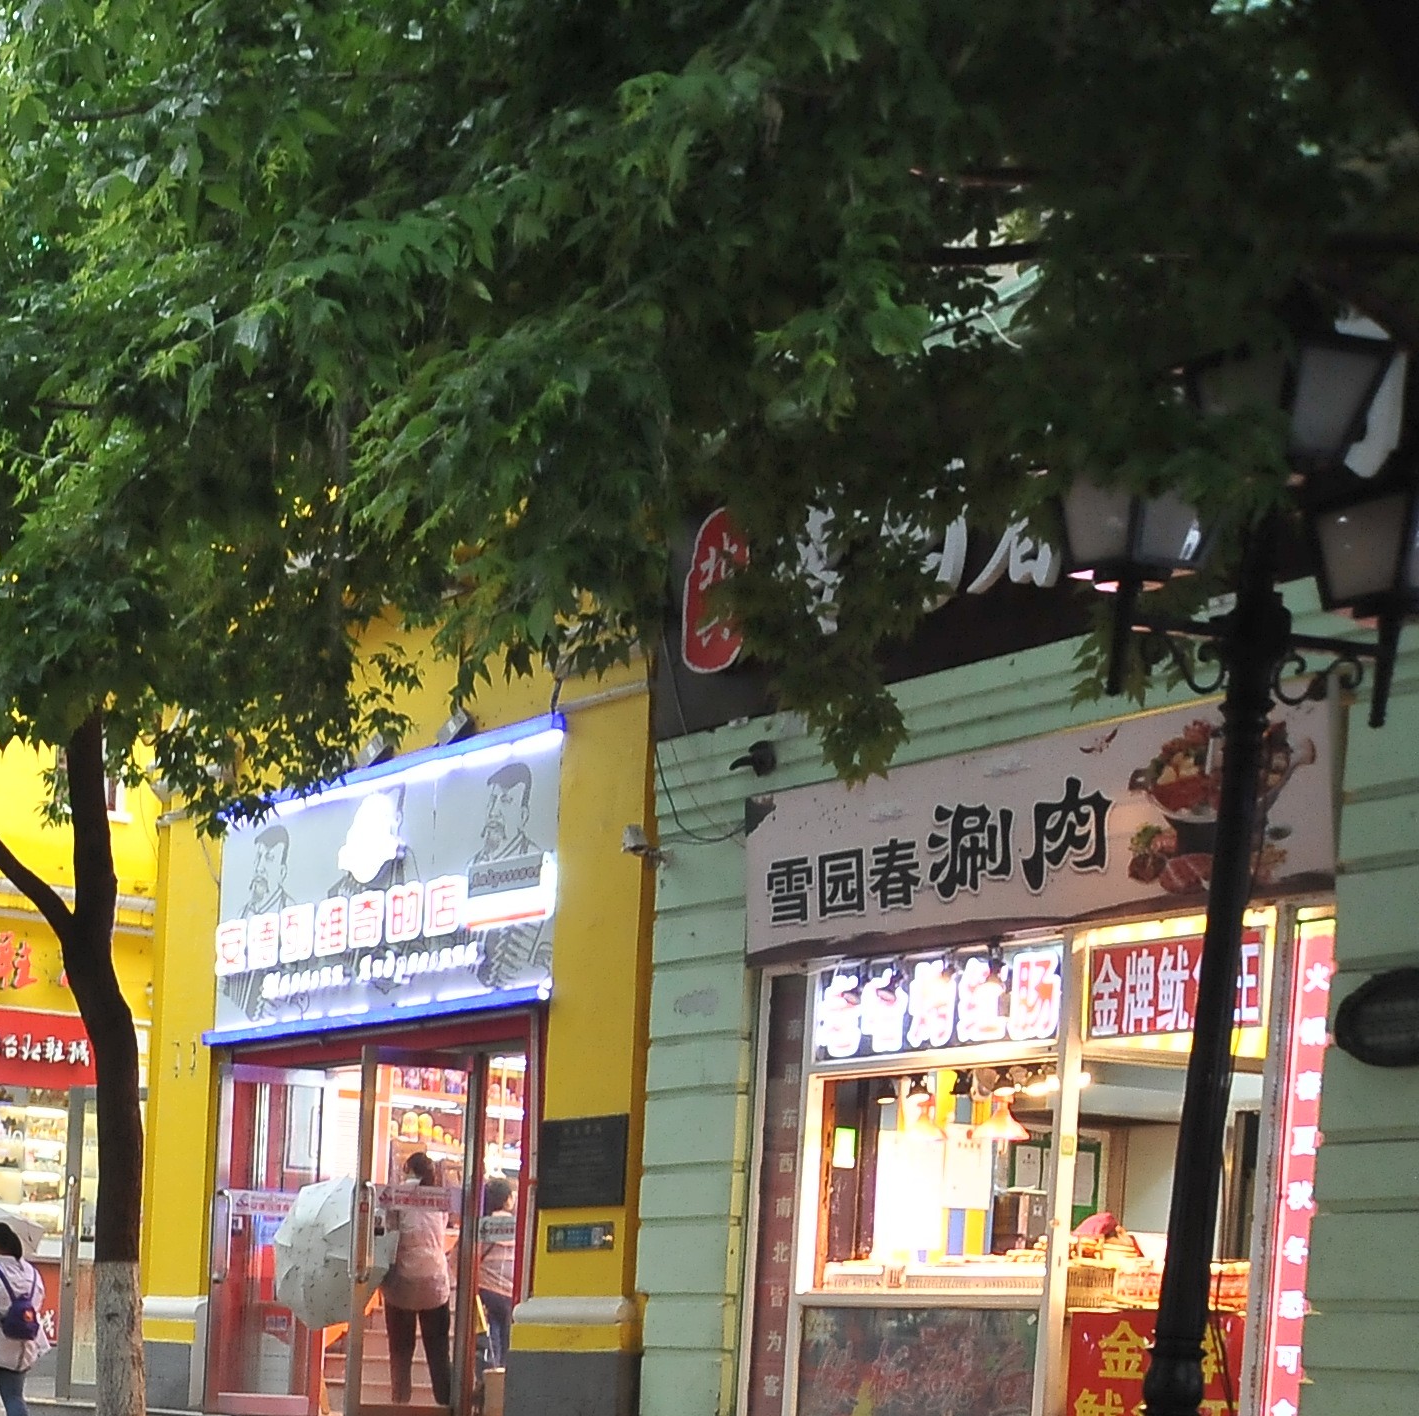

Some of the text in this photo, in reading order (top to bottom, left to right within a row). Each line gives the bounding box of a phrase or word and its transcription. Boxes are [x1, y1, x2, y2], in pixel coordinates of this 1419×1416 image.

[766, 776, 1113, 923] 雪园春涮肉
[1092, 943, 1260, 1036] 金牌鱿王
